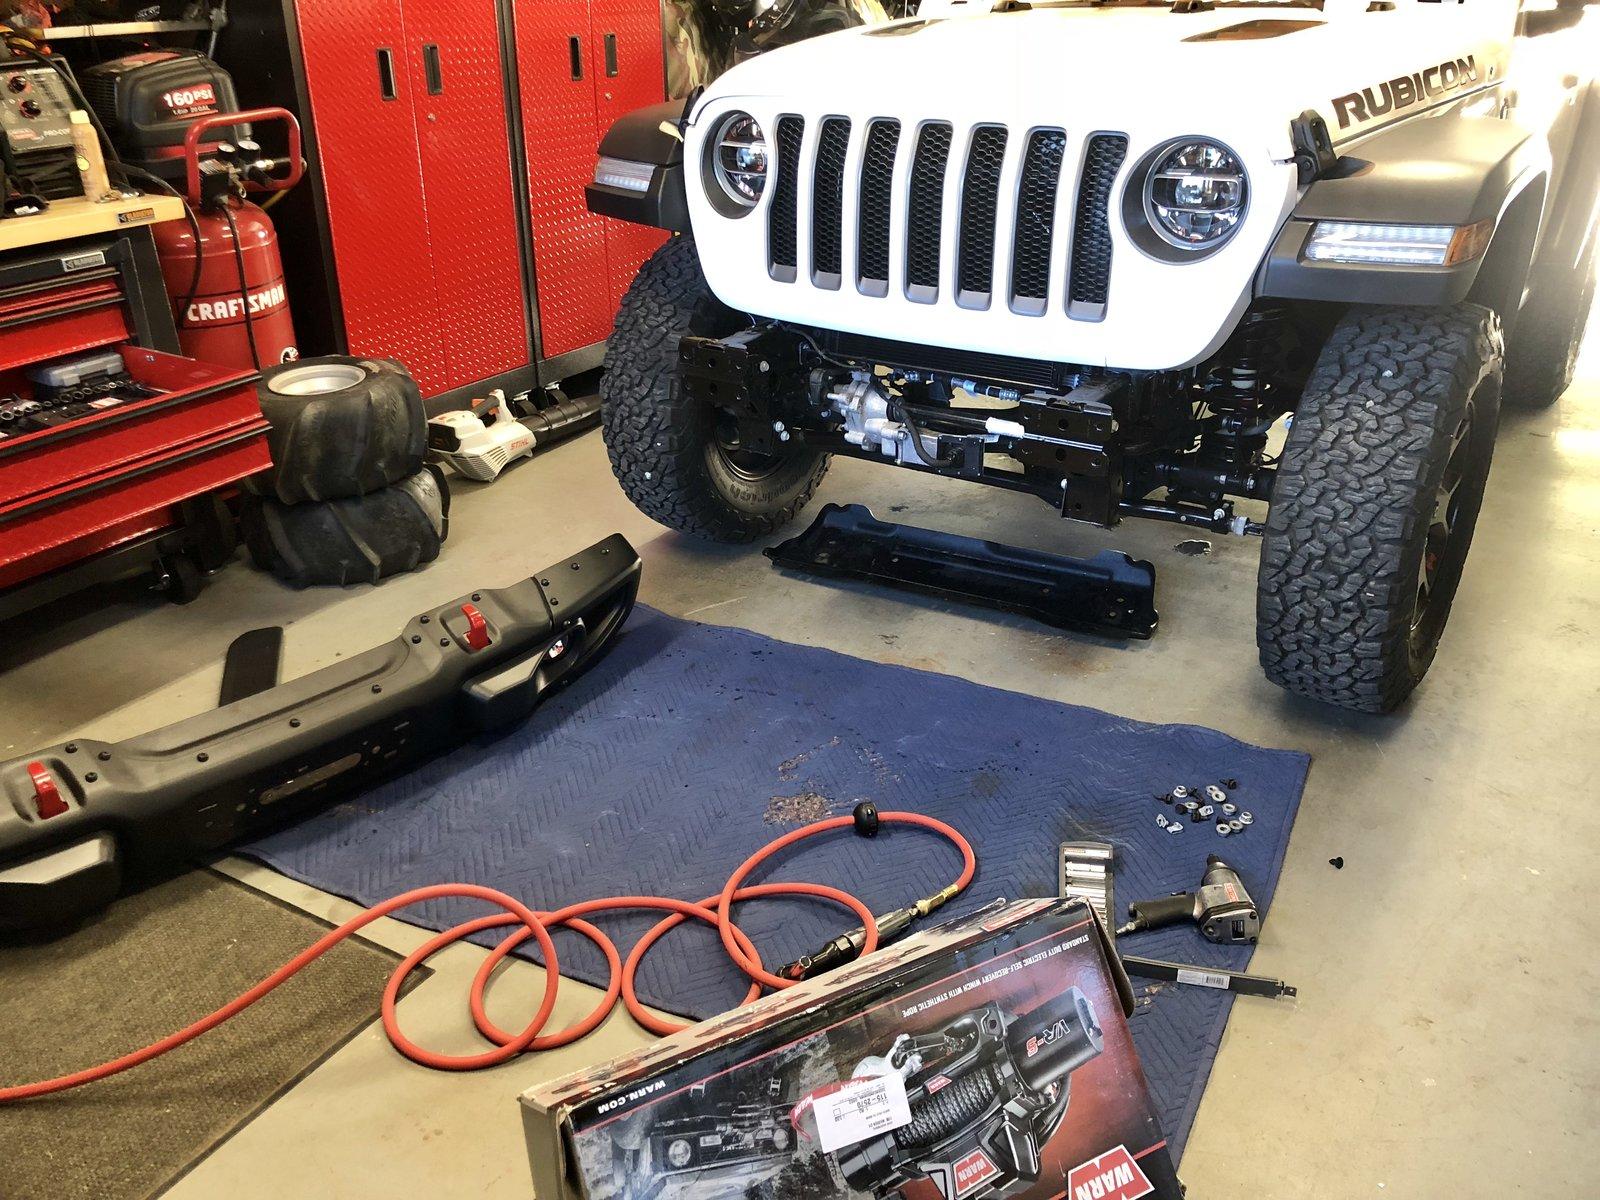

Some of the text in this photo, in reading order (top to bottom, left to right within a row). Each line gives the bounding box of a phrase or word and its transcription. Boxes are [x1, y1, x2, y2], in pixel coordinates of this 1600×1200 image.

[163, 89, 213, 107] 160 PSI
[1331, 55, 1477, 129] RUBICON
[187, 284, 285, 322] CRAFTSMAN
[511, 438, 529, 450] STIHL
[1047, 944, 1062, 956] DUTY
[1061, 934, 1089, 950] STANDARD
[1022, 950, 1047, 967] ELECTRIC
[980, 960, 1023, 983] SELF-RECOVERY
[962, 978, 981, 991] WINCH
[917, 992, 948, 1010] SYNTHETIC
[900, 1004, 918, 1017] ROPE
[598, 1079, 666, 1115] WARN.COM
[958, 1158, 987, 1182] WARN
[1075, 1161, 1135, 1200] WARN
